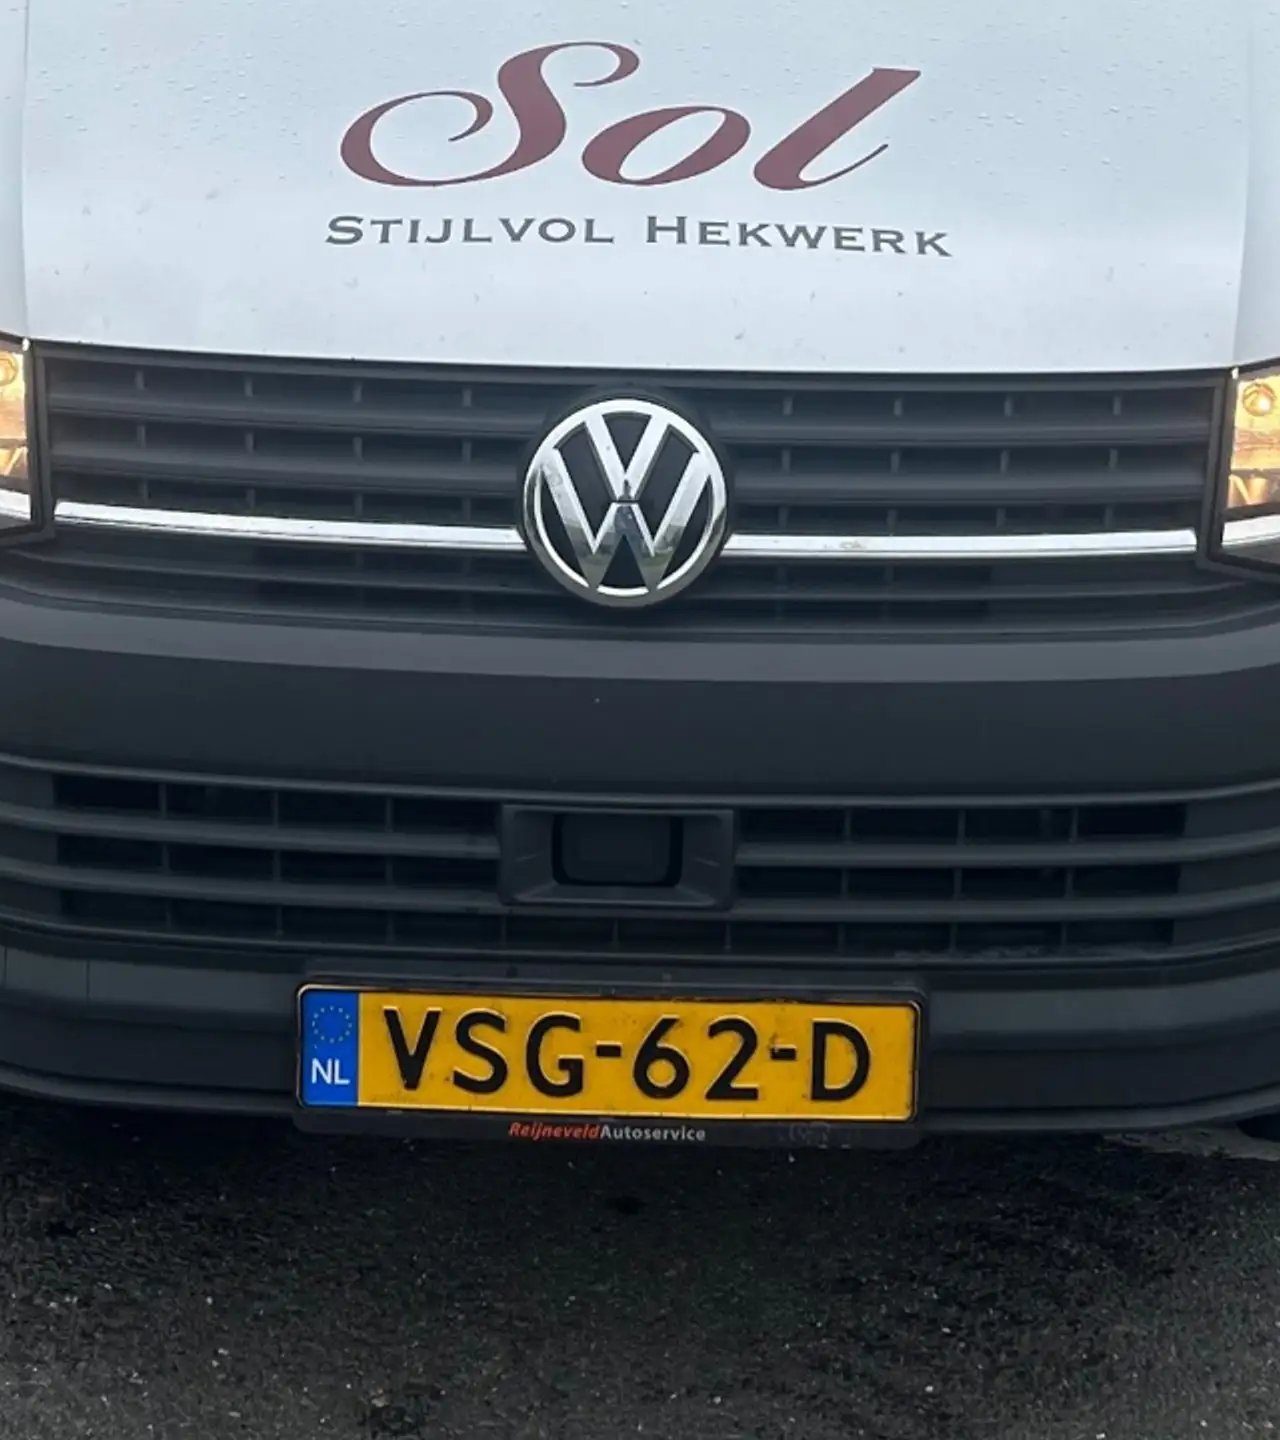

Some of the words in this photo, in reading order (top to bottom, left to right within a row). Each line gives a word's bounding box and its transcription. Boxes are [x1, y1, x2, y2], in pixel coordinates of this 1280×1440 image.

[340, 41, 922, 190] Sol
[312, 1058, 350, 1086] NL
[383, 1007, 872, 1101] VSG-62-D
